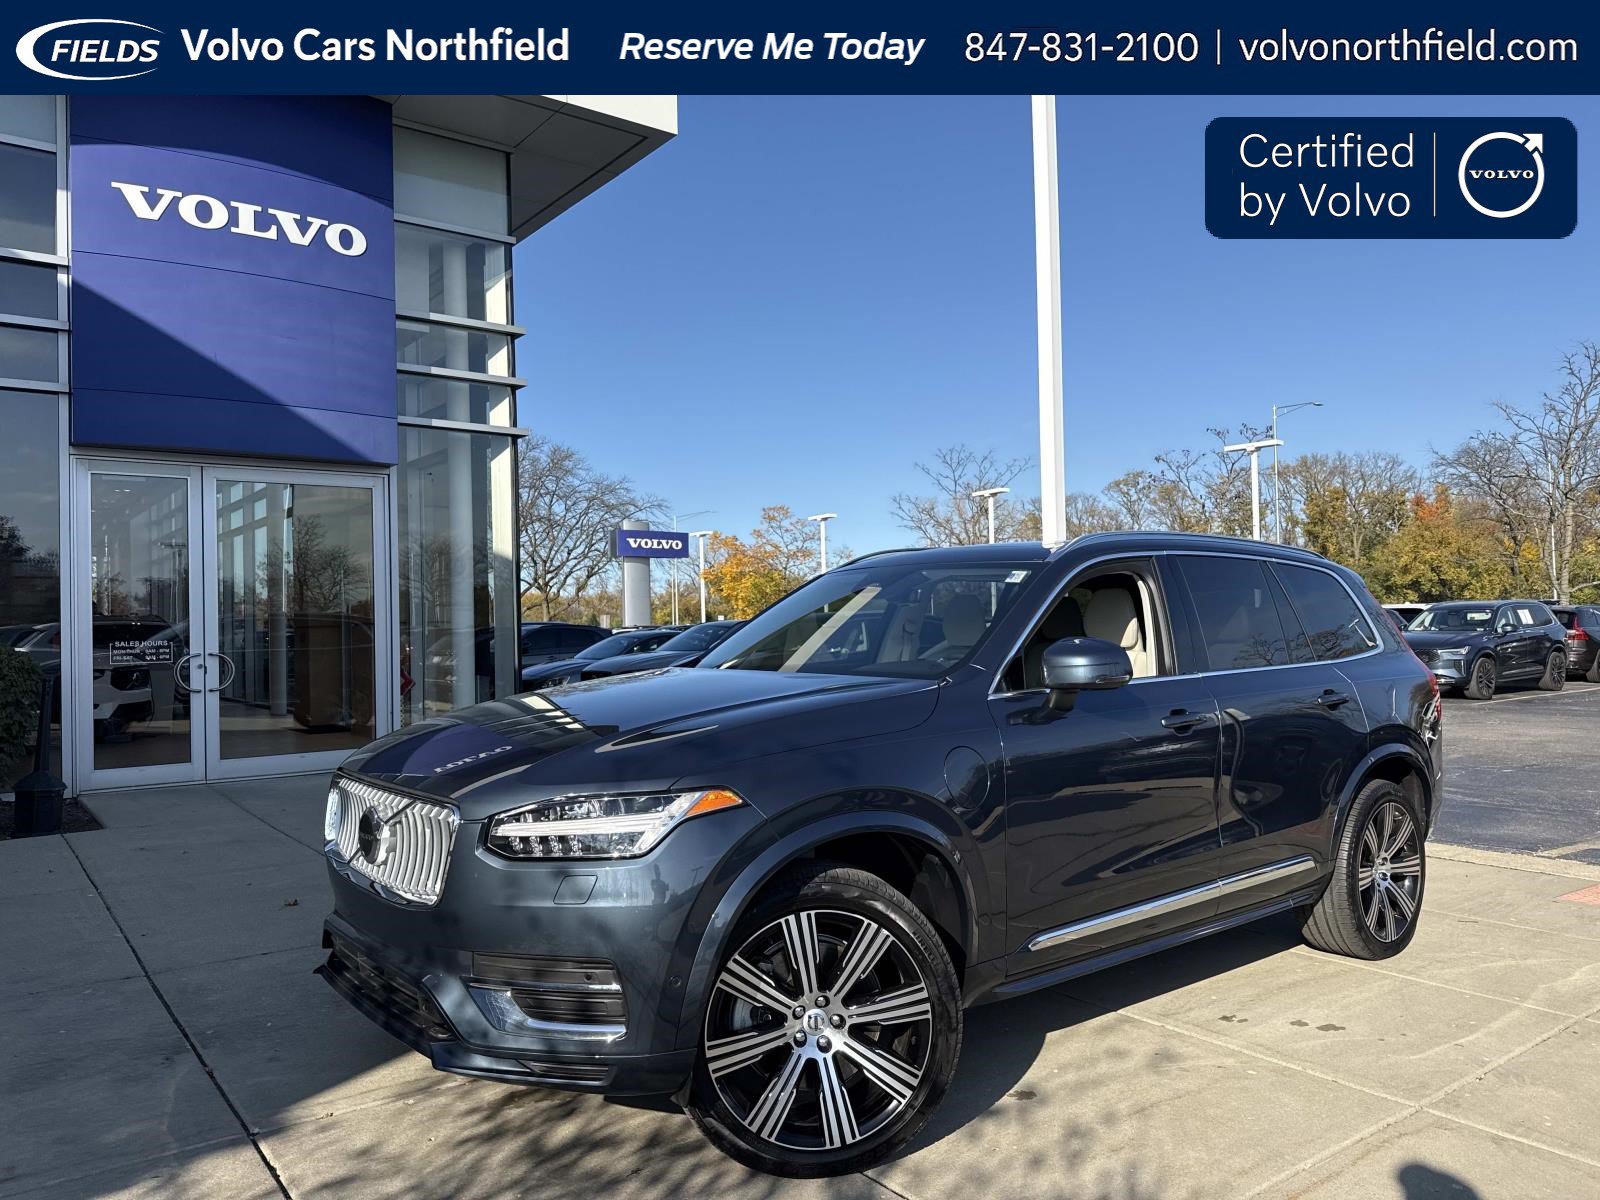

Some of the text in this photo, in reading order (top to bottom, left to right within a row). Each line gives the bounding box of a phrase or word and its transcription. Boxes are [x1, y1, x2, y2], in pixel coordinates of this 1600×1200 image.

[110, 181, 367, 257] VOLVO
[626, 537, 683, 550] VOLVO
[142, 640, 168, 648] HOURS
